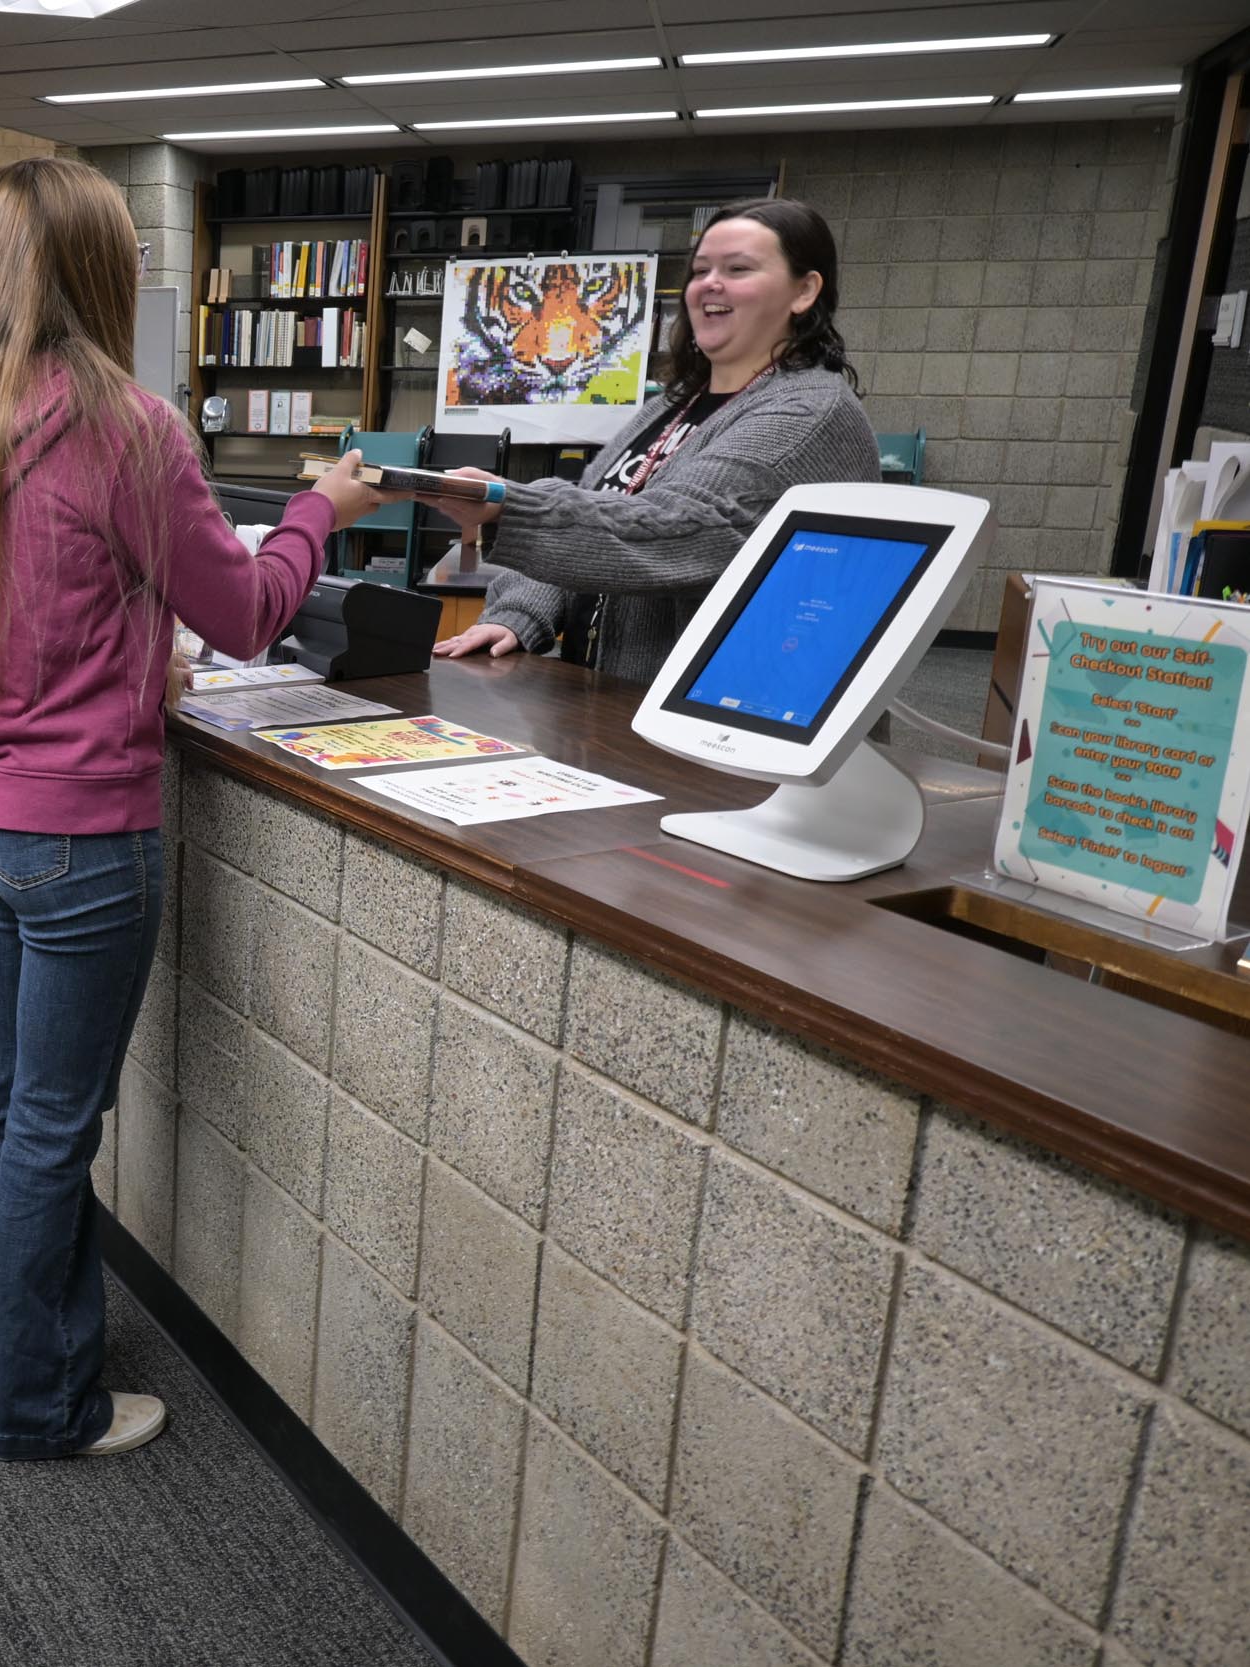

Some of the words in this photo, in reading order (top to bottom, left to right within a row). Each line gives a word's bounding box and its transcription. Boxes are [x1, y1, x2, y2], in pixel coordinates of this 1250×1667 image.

[1081, 633, 1106, 652] Try
[1111, 640, 1137, 655] out
[1141, 644, 1170, 659] our
[1175, 648, 1214, 665] Self-
[1071, 655, 1142, 678] Checkout
[1147, 668, 1213, 690] Station!
[1093, 694, 1131, 711] Select
[1051, 722, 1079, 739] Scan
[1084, 729, 1112, 748] your
[1116, 733, 1158, 756] library
[1163, 744, 1195, 763] card
[1199, 754, 1215, 767] or
[1074, 747, 1107, 763] enter
[1111, 754, 1141, 771] your
[1145, 760, 1180, 779] 900#
[1045, 793, 1096, 815] barcode
[1099, 807, 1113, 819] to
[1116, 811, 1153, 829] check
[1158, 821, 1166, 833] it
[1170, 826, 1194, 840] out
[1048, 776, 1077, 793] Scan
[1081, 782, 1102, 798] the
[1106, 788, 1148, 808] book's
[1152, 799, 1197, 824] library
[1039, 828, 1076, 846] Select
[1124, 850, 1138, 864] to
[1142, 854, 1186, 877] logout
